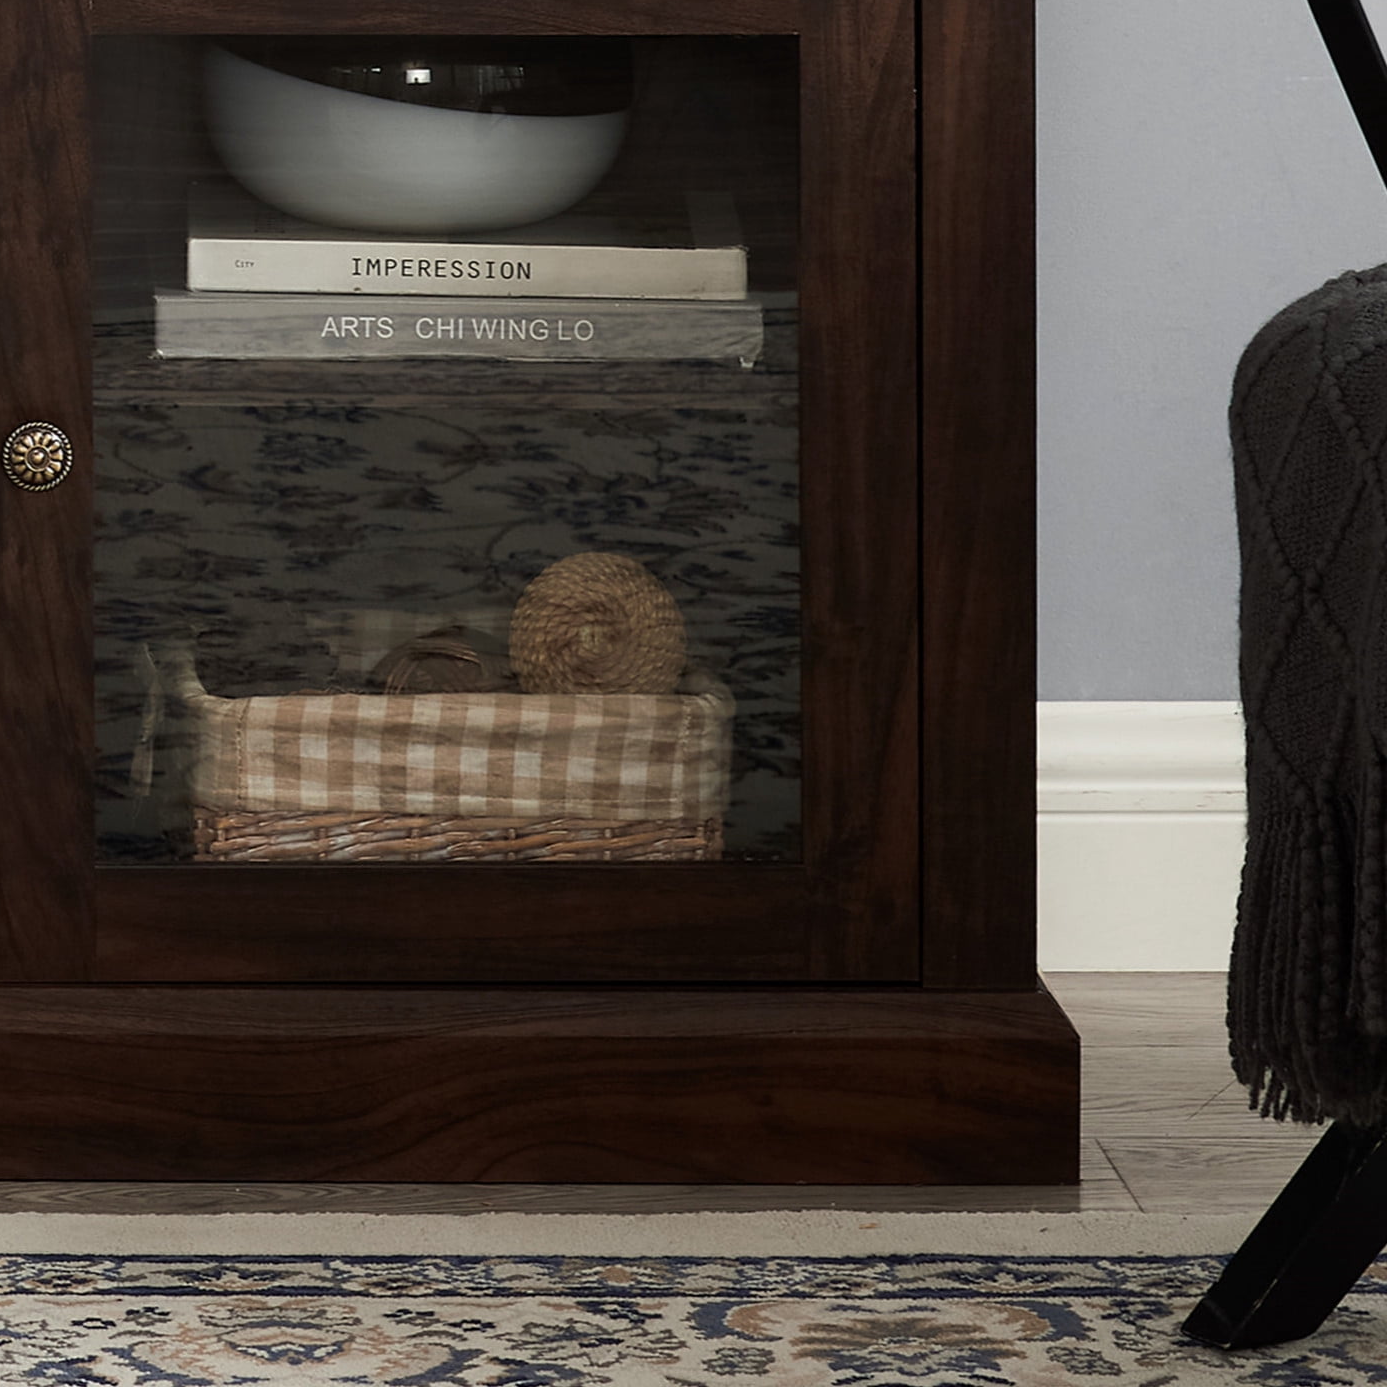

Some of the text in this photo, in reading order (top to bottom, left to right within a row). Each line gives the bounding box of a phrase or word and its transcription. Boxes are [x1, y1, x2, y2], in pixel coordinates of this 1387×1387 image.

[351, 257, 531, 280] IMPERESSION
[320, 316, 594, 341] ARTS CHI WING LO
